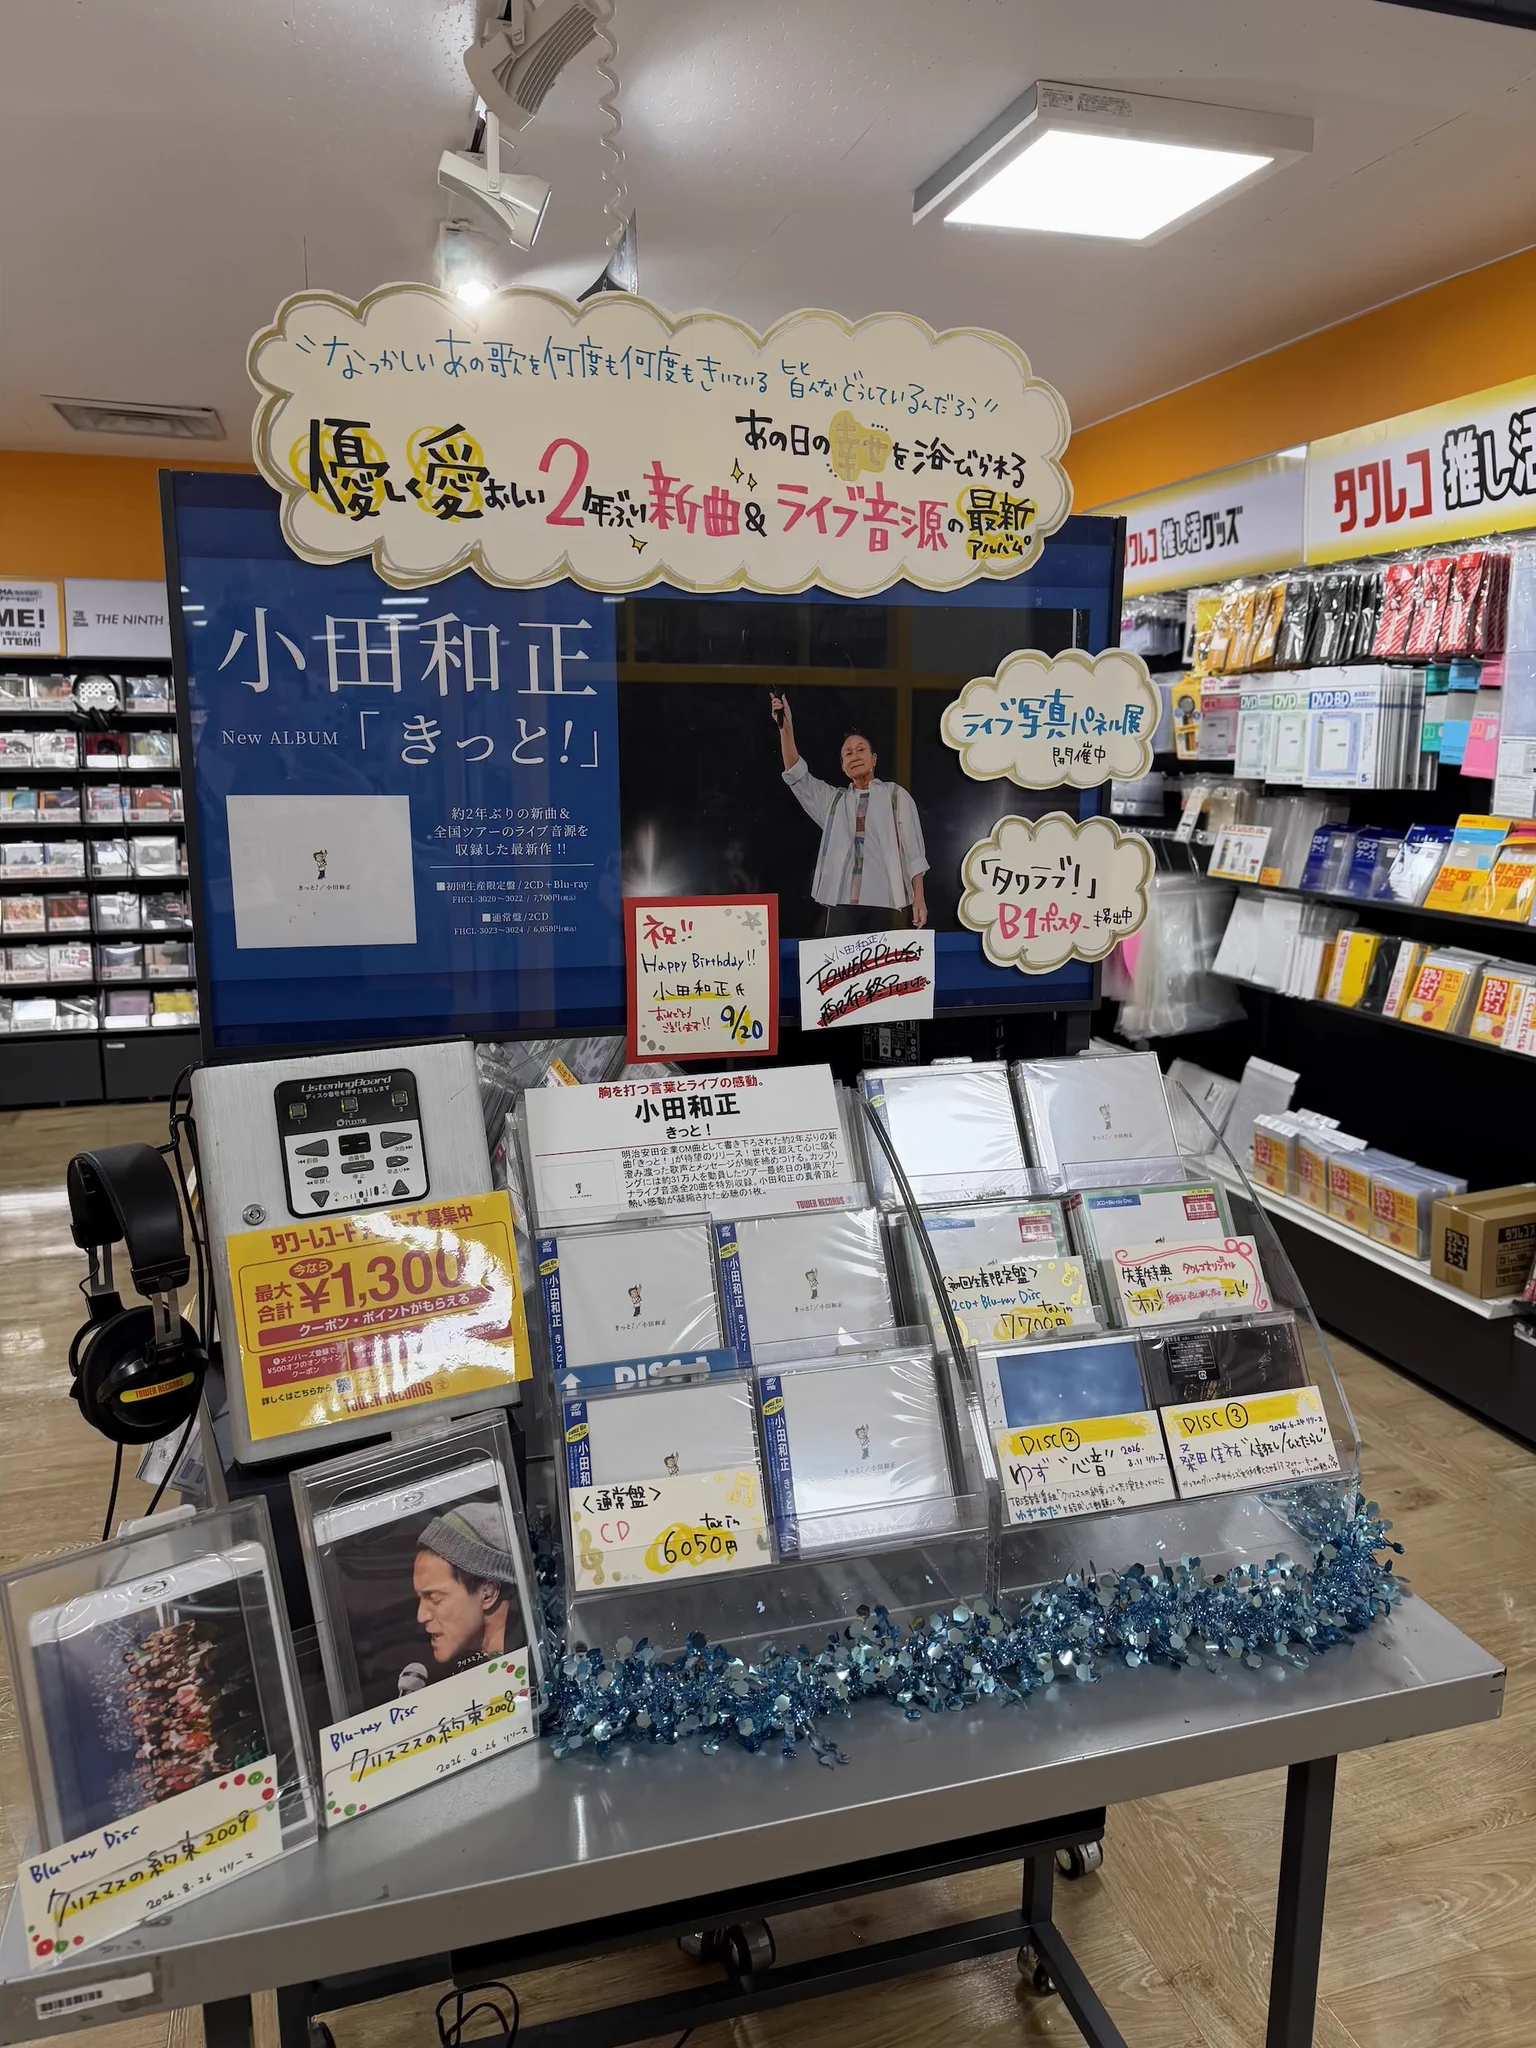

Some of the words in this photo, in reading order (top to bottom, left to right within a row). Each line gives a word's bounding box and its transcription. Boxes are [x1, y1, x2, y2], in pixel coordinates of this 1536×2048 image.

[1334, 448, 1432, 533] タワレコ
[1161, 505, 1243, 559] 推し活グッズ
[96, 613, 119, 624] THE
[122, 614, 164, 625] NINTH
[217, 606, 598, 697] 小田和正
[962, 689, 1145, 739] ライブ写真パネル展
[1273, 693, 1297, 709] DVD
[221, 730, 262, 745] New
[269, 730, 338, 745] ALBUM
[1053, 741, 1106, 767] 開催中
[451, 807, 570, 820] 約2年ぶりの新曲&
[434, 825, 589, 839] 全国ツアーのライブ音源を
[1356, 850, 1376, 859] ケース
[998, 902, 1090, 939] B1ポスター
[641, 953, 687, 974] Happy
[806, 947, 872, 996] TOWER
[720, 1005, 764, 1040] 9/20
[301, 1075, 392, 1093] ListeningBoard
[598, 1074, 764, 1099] 胸を打つ言葉とライブの感動。
[635, 1092, 740, 1124] 小田和正
[796, 1199, 817, 1209] TOWER
[271, 1221, 356, 1256] タワーレコード
[425, 1204, 473, 1229] 募集中
[293, 1259, 330, 1278] 今なら
[296, 1246, 467, 1314] ¥1,300
[1121, 1263, 1172, 1288] 先着特典
[255, 1281, 293, 1303] 最大
[729, 1258, 744, 1308] 小田和正
[549, 1274, 562, 1328] 小田和正
[1018, 1288, 1041, 1305] Disc
[257, 1302, 295, 1324] 合計
[299, 1293, 470, 1337] クーポン・ポイントがもらえる
[292, 1366, 320, 1379] クーポン
[261, 1383, 332, 1406] 詳しくはこちらから
[774, 1414, 791, 1471] 小田和正
[1179, 1443, 1242, 1473] 桑田佳祐
[1008, 1458, 1049, 1492] ゆず
[600, 1520, 630, 1543] CD
[699, 1513, 723, 1531] tax
[725, 1516, 740, 1527] in
[663, 1530, 738, 1564] 6050円
[330, 1721, 382, 1751] Blu-ray
[390, 1705, 418, 1725] Disc
[29, 1846, 98, 1884] Blu-ray
[103, 1825, 140, 1849] Disc
